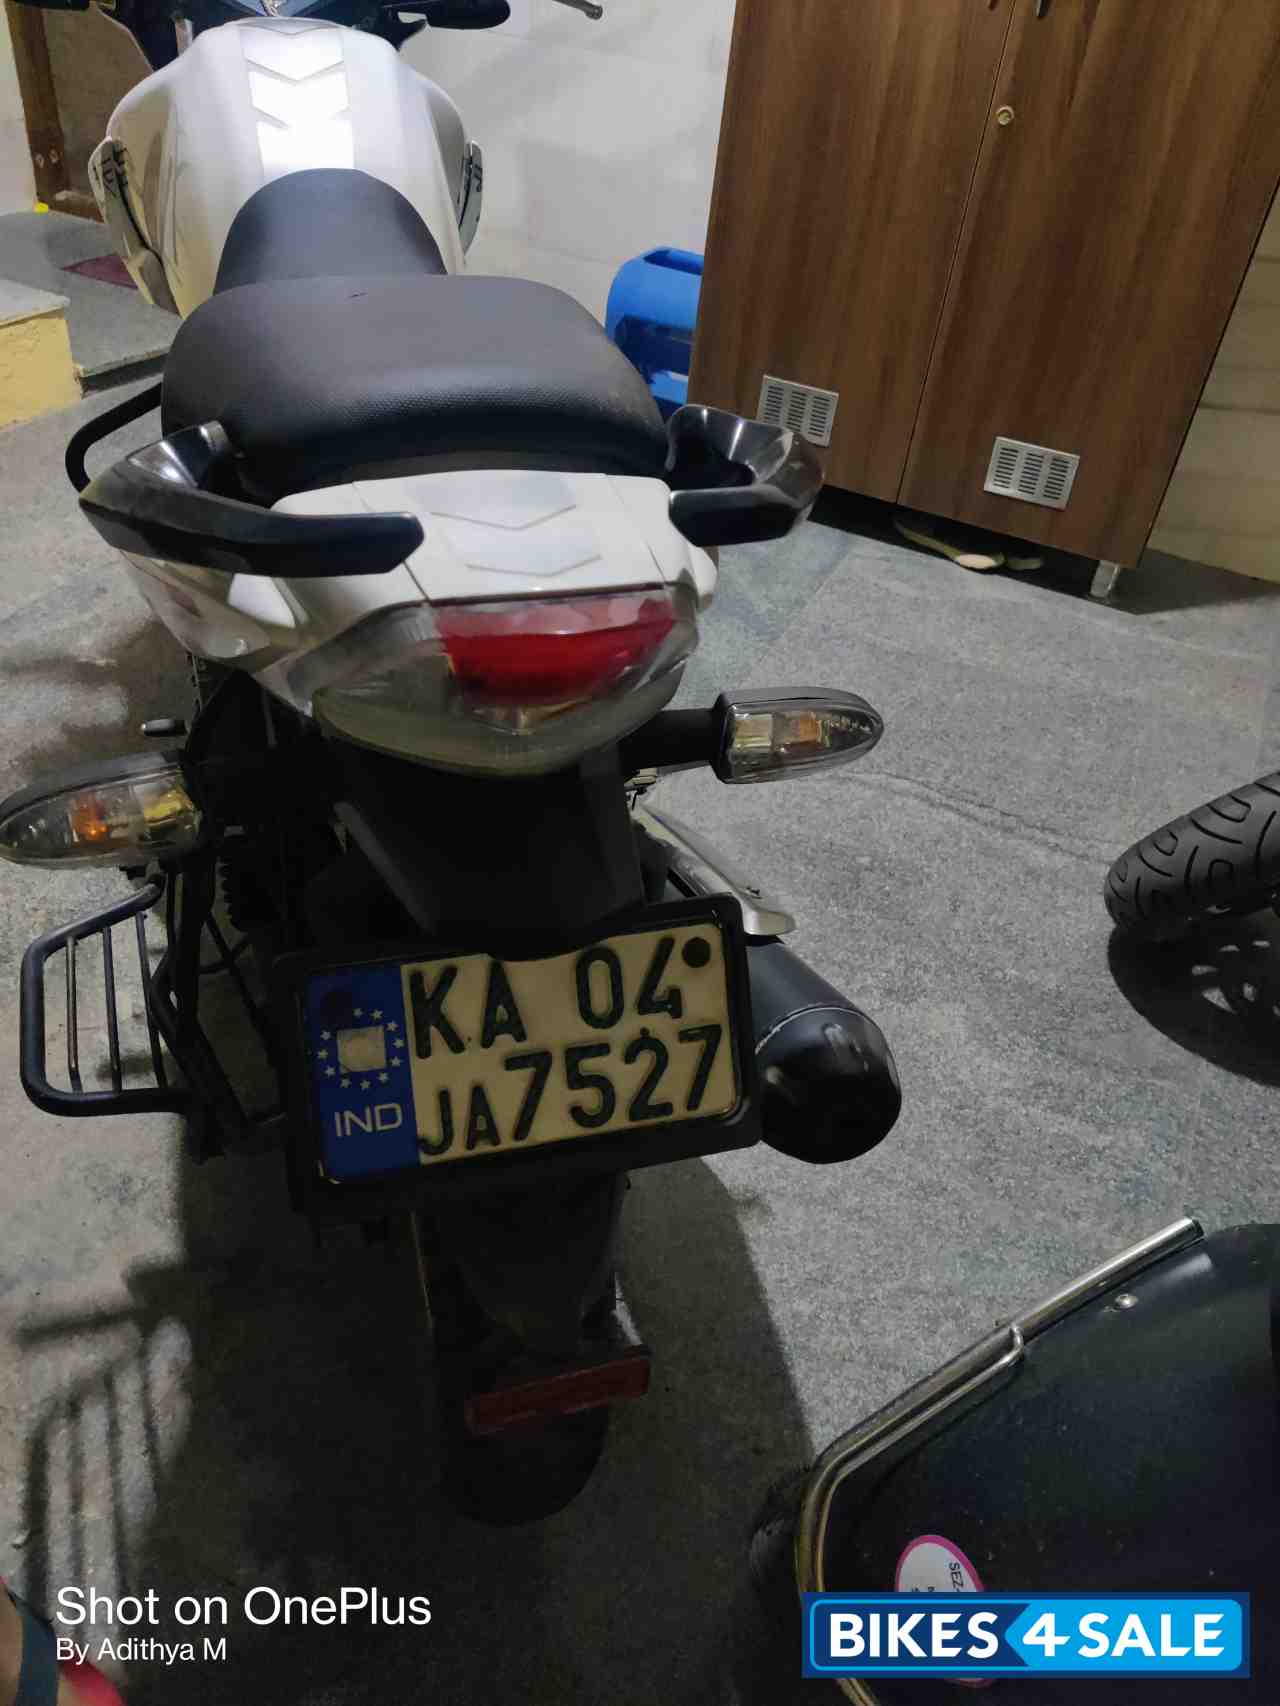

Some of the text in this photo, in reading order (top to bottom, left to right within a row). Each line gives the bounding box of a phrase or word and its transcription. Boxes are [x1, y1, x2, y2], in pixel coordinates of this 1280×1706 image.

[409, 937, 682, 1059] KA 04
[334, 1102, 402, 1137] IND
